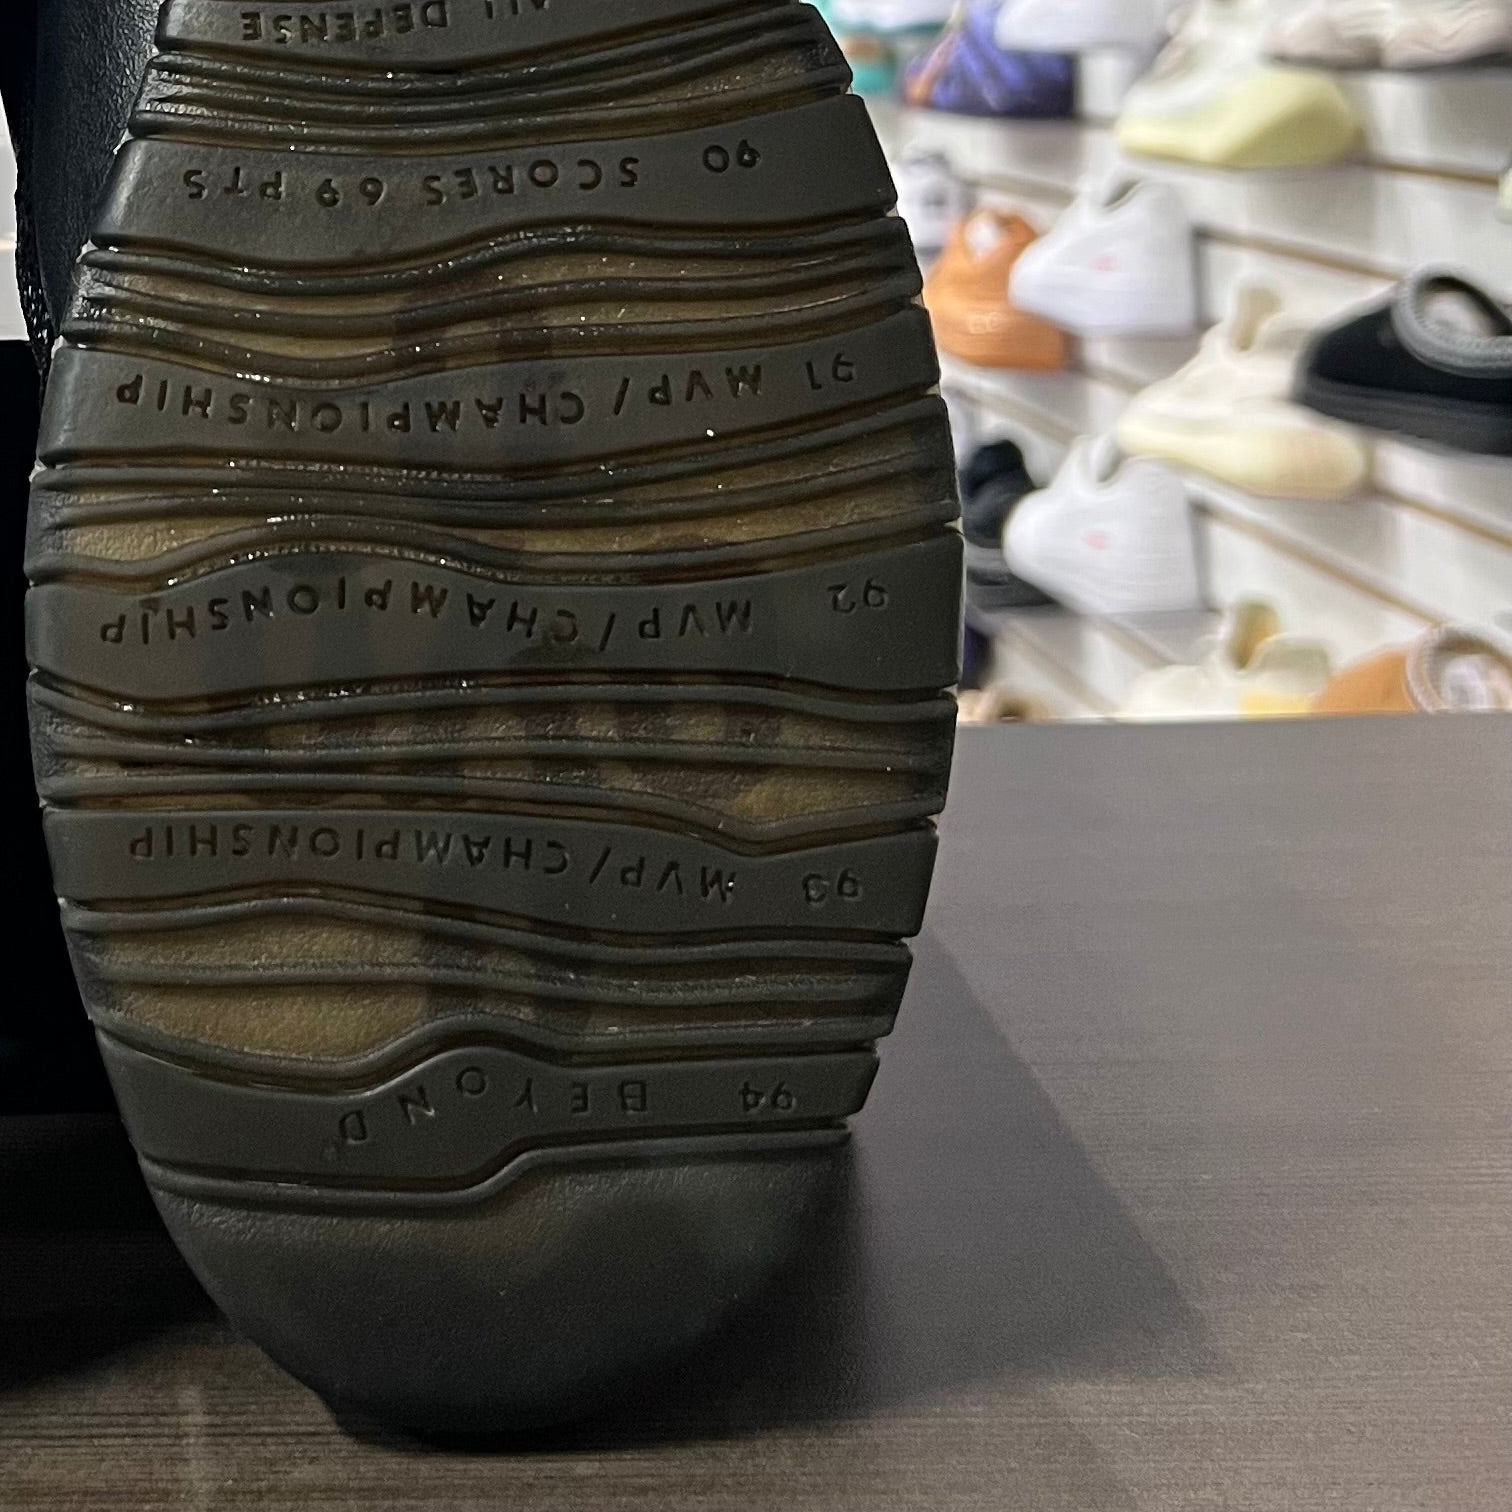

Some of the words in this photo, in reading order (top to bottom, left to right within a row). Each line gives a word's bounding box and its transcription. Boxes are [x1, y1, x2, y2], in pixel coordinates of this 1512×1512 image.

[241, 0, 449, 44] DEFENSE
[702, 139, 760, 174] 90
[183, 168, 283, 201] PTS
[315, 176, 385, 208] 69
[424, 157, 639, 207] SCORES
[806, 354, 857, 394] 91
[828, 583, 888, 615] 92
[803, 872, 862, 906] 93
[337, 1065, 647, 1143] BEYOND
[738, 1080, 797, 1115] 94
